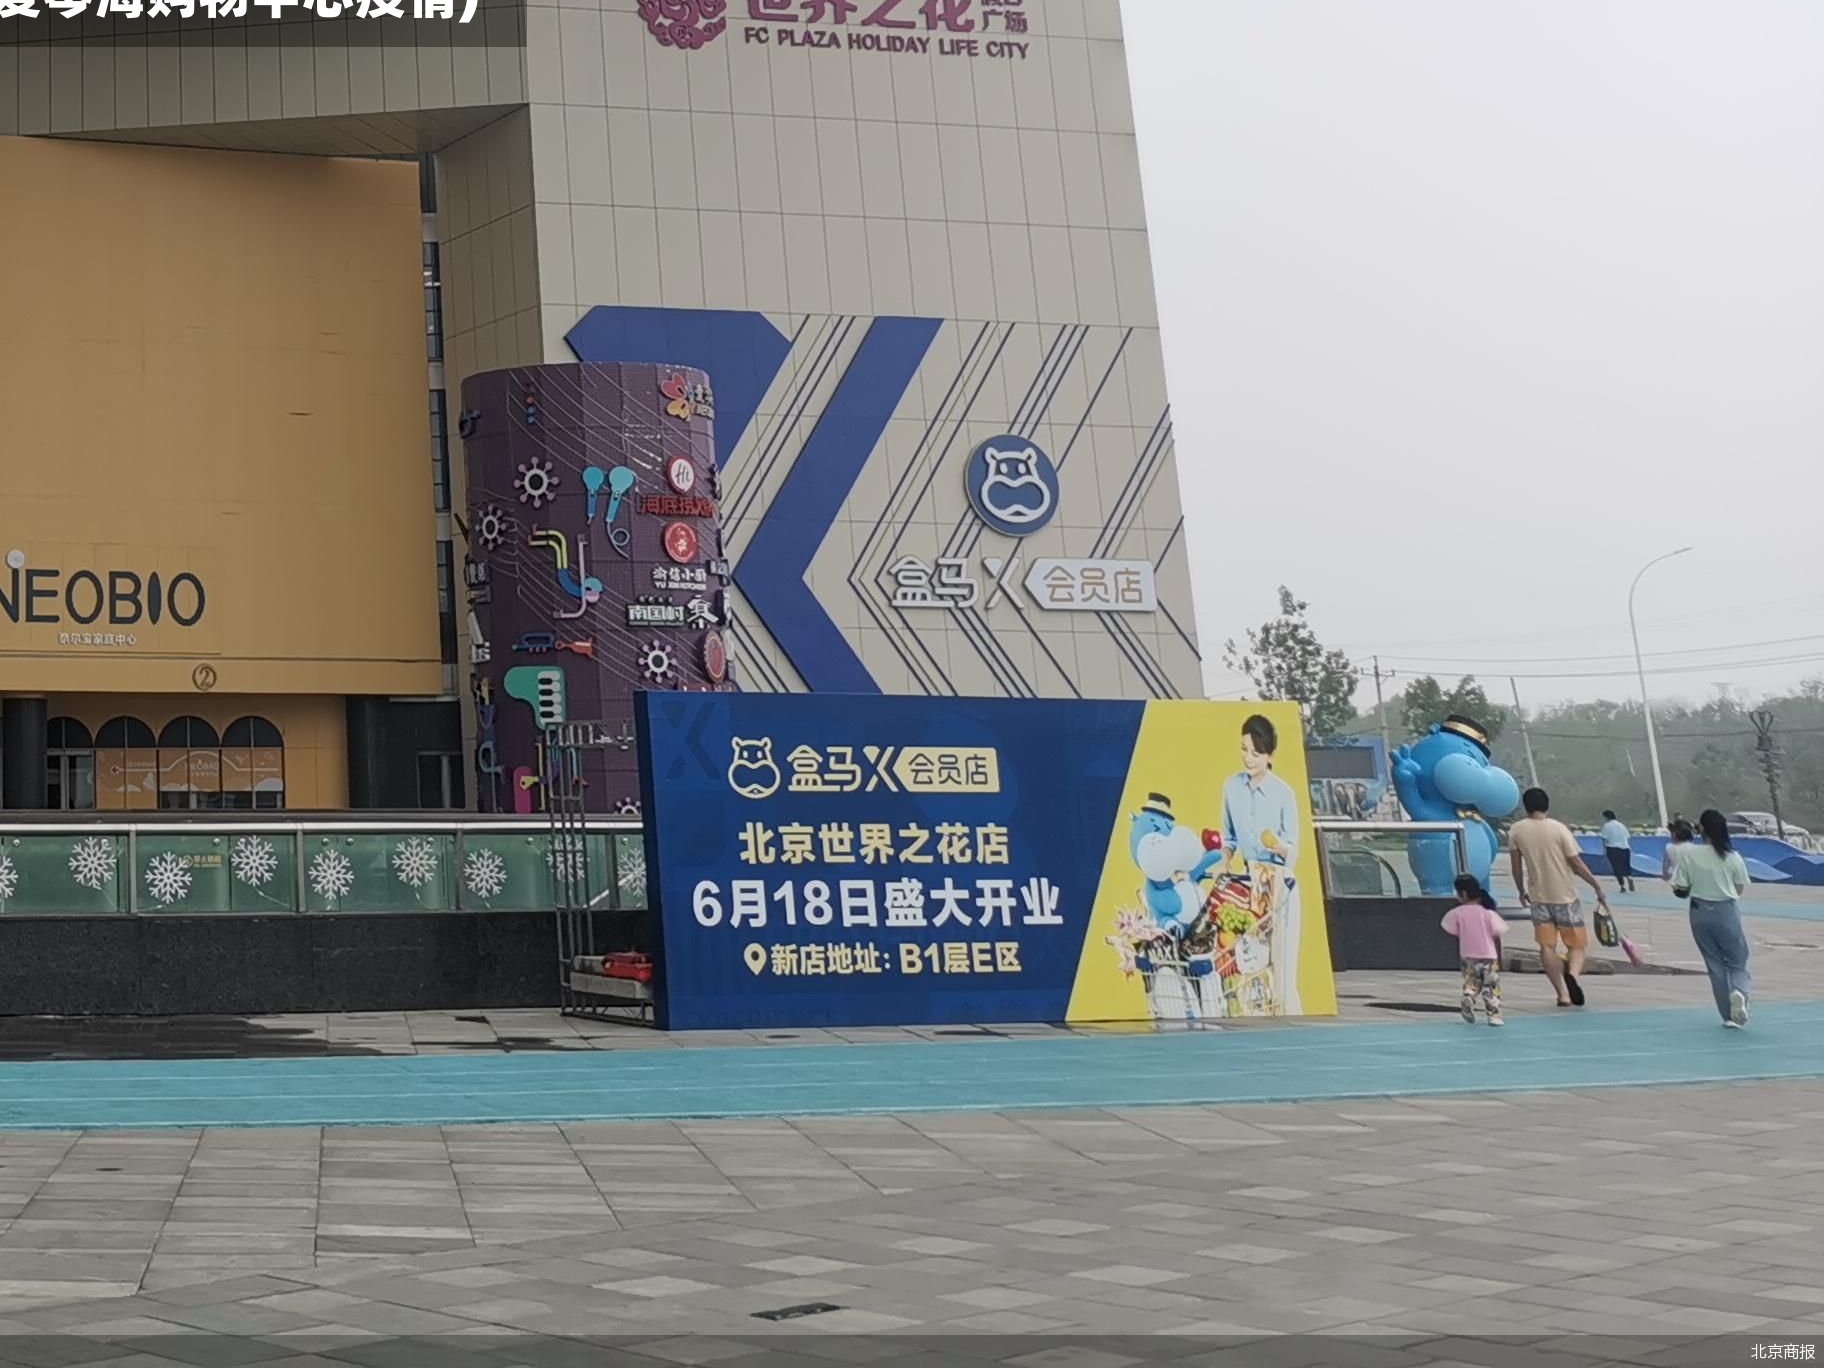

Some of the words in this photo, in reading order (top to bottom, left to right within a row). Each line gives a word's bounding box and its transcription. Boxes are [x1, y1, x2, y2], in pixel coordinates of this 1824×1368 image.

[981, 8, 1029, 33] 广场
[744, 26, 770, 44] FC
[778, 29, 841, 50] PLAZA
[848, 32, 931, 55] HOLIDAY
[939, 38, 979, 58] LIFE
[986, 41, 1030, 60] CITY
[738, 821, 1010, 865] 北京世界之花店
[692, 877, 1064, 928] 6月18日盛大开业
